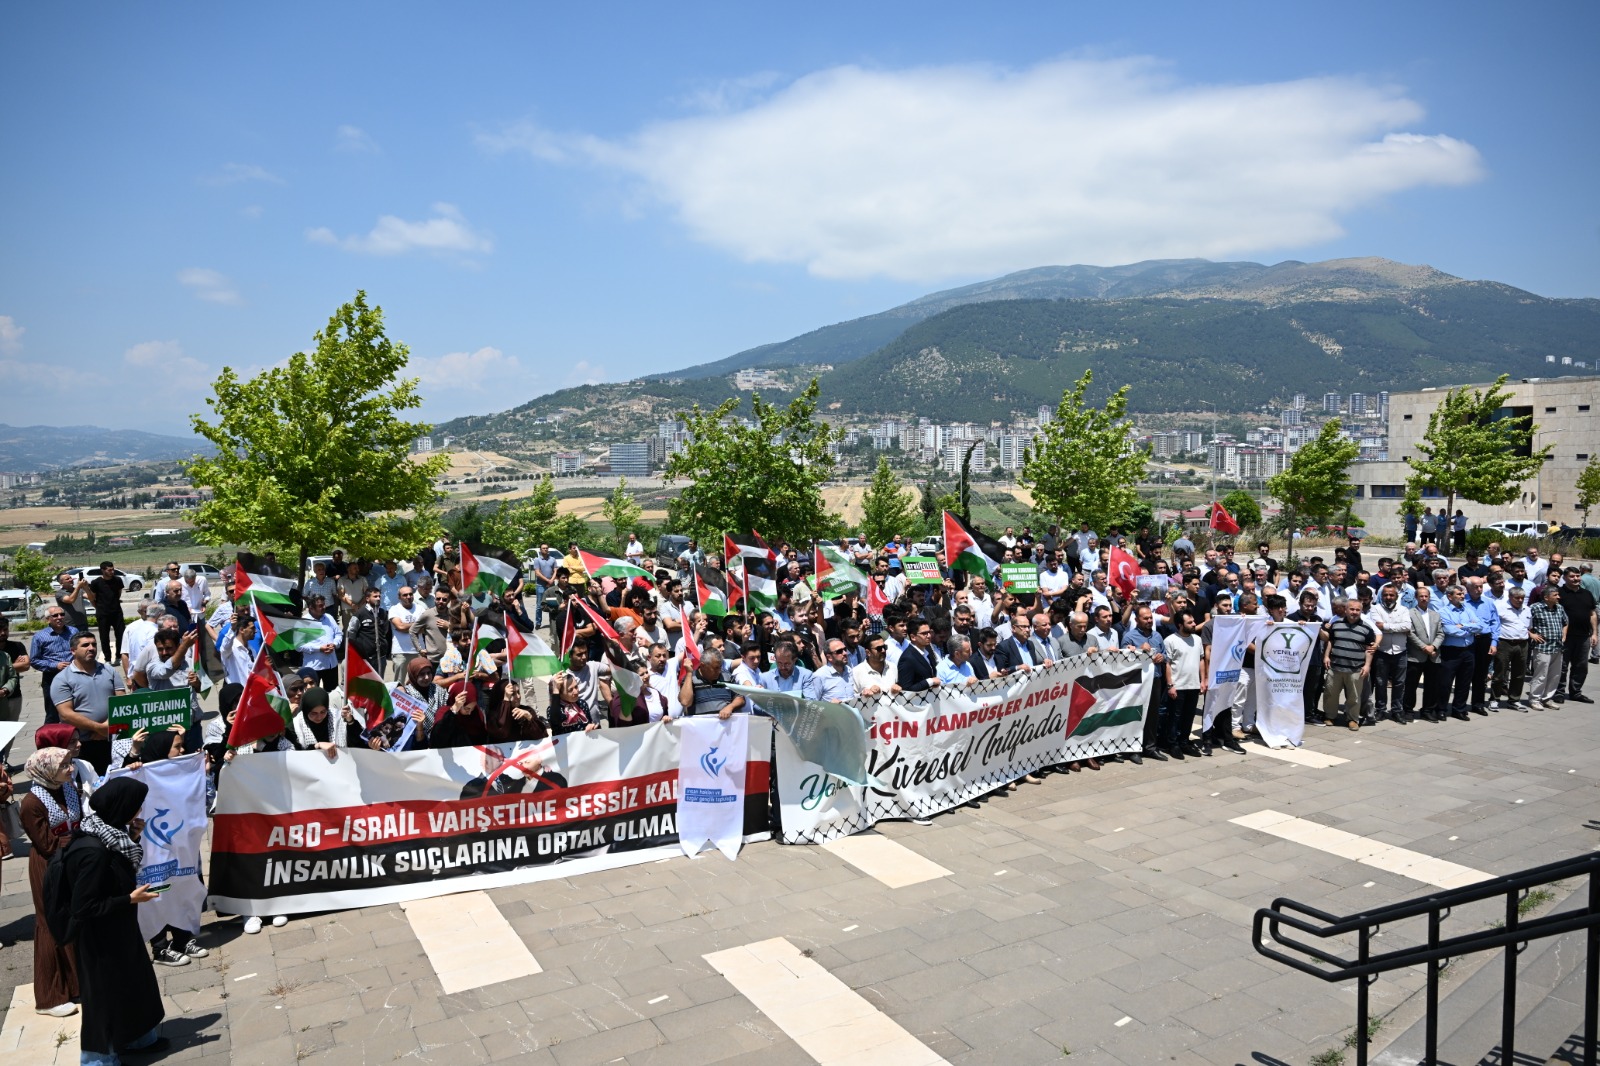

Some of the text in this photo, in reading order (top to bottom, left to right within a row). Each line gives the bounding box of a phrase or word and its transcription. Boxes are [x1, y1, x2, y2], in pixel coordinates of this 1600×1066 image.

[112, 698, 188, 718] AKSA TUFANINA
[132, 713, 184, 729] BİN SELAM!
[870, 681, 1068, 745] İÇİN KAMPÜSLER AYAĞA
[862, 736, 975, 801] Küresel
[428, 799, 557, 833] VAHŞETİNE
[565, 786, 638, 819] SESSİZ
[263, 812, 679, 887] İNSANLIK SUÇLARINA ORTAK OLMA
